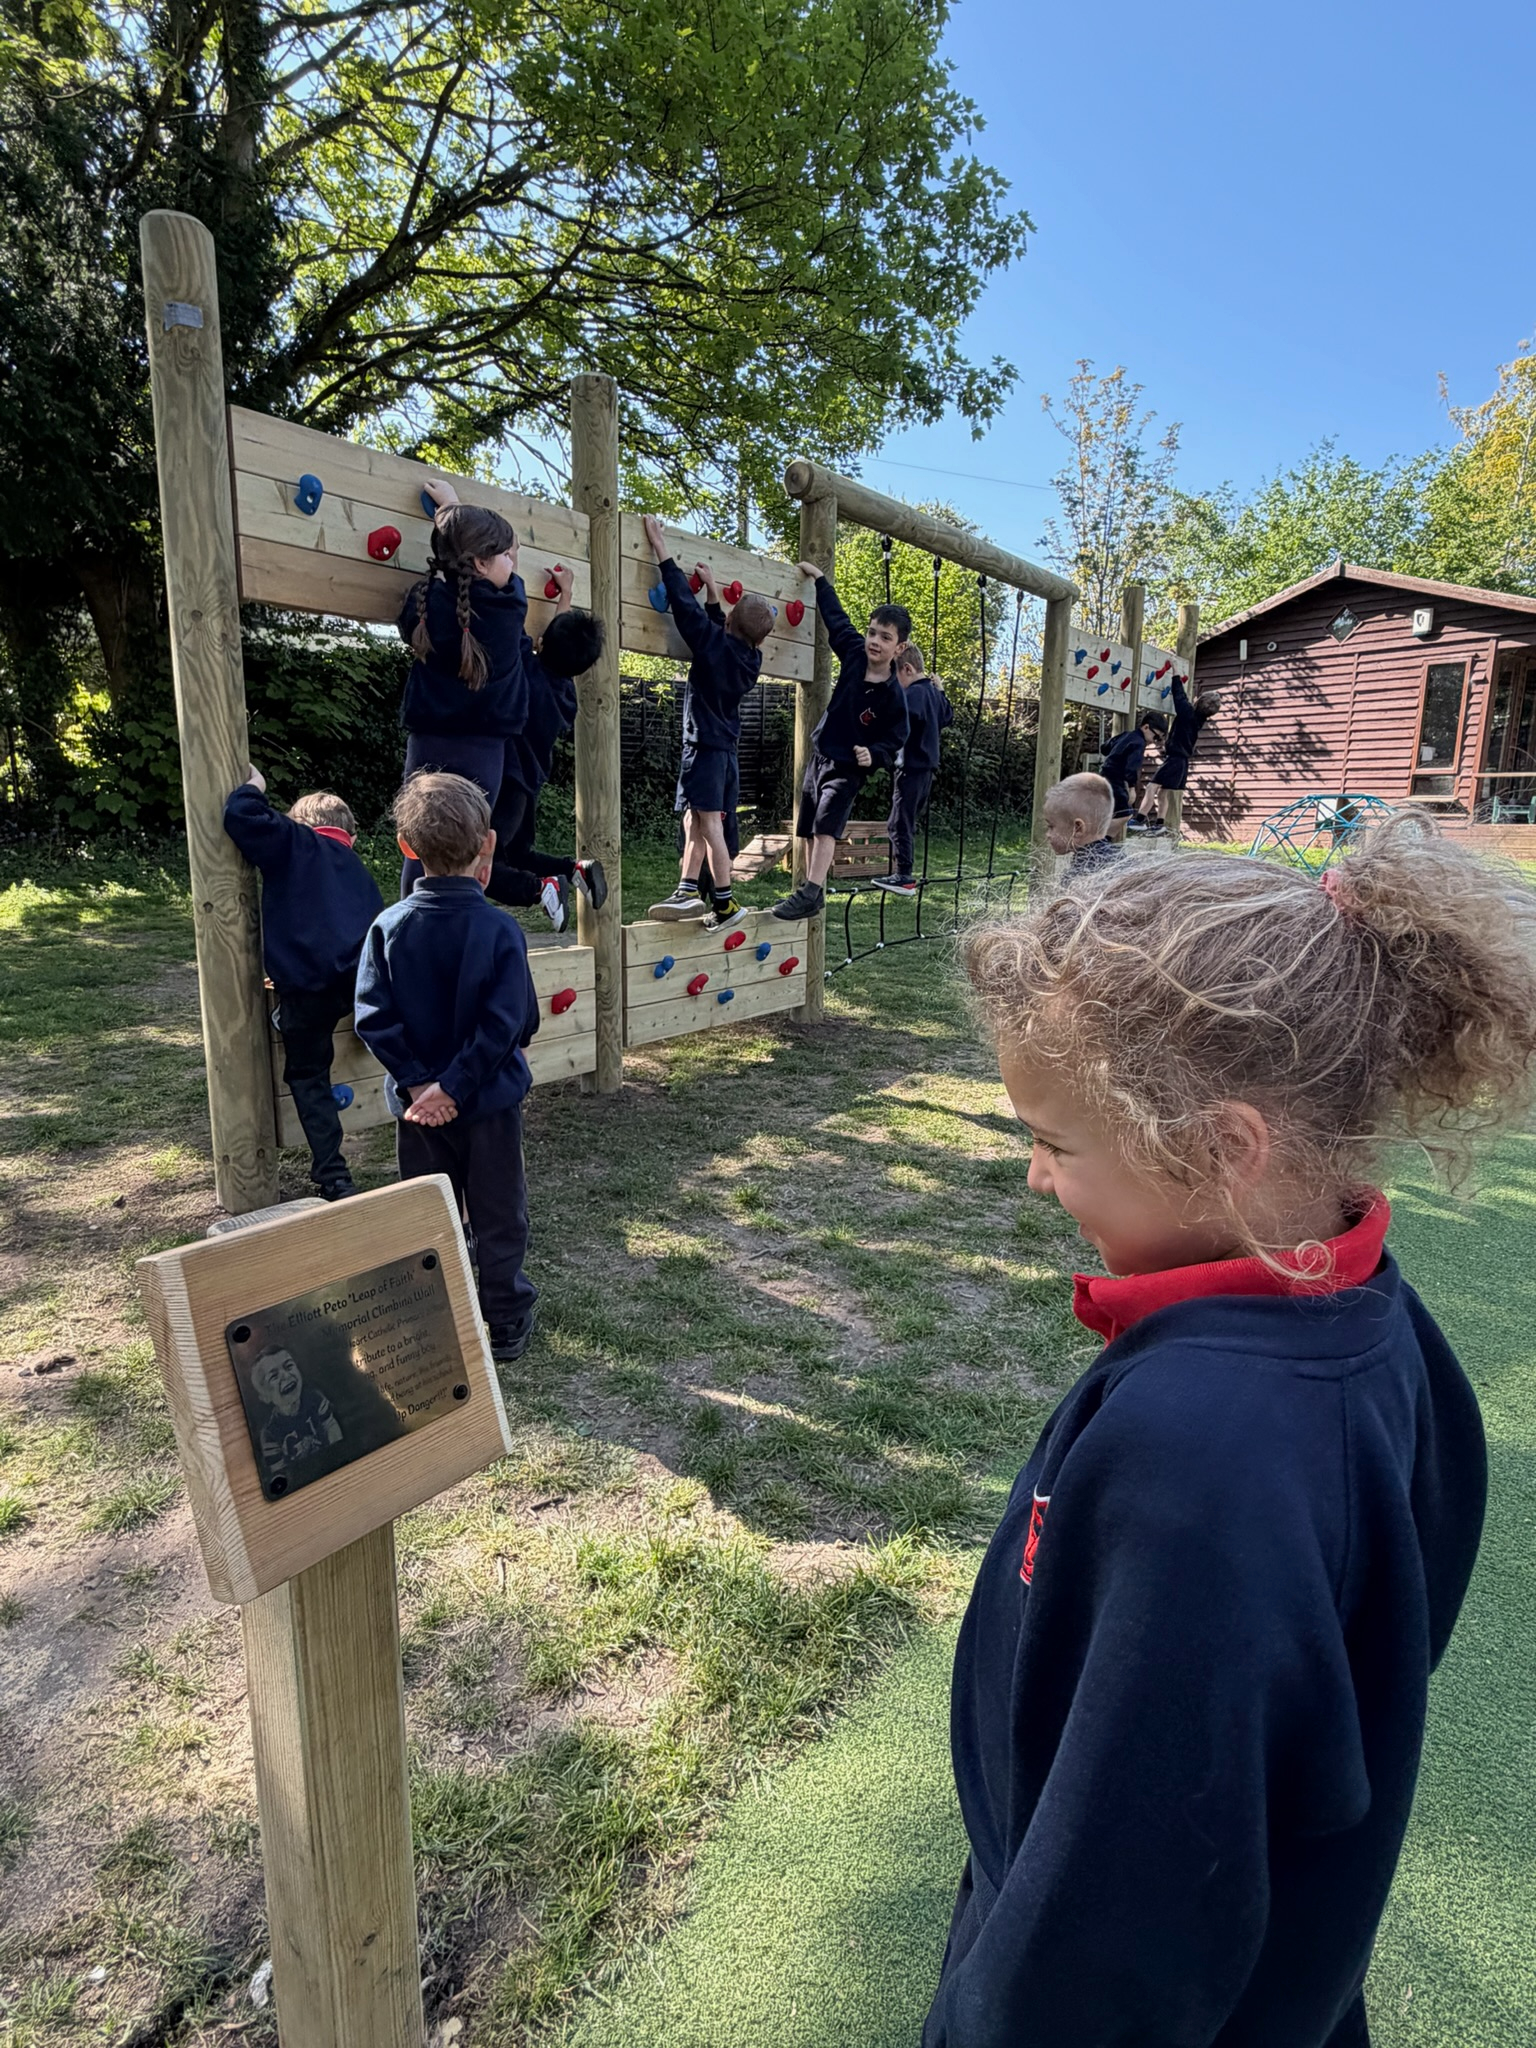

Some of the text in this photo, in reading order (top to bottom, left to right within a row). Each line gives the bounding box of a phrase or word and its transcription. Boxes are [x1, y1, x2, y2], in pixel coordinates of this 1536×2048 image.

[287, 1307, 322, 1328] Elliott
[323, 1299, 348, 1315] Peto
[377, 1279, 388, 1294] of
[413, 1284, 435, 1302] Wall
[355, 1348, 386, 1368] tribute
[387, 1344, 396, 1354] to
[396, 1341, 403, 1350] a
[378, 1359, 396, 1375] and
[396, 1350, 421, 1368] funny
